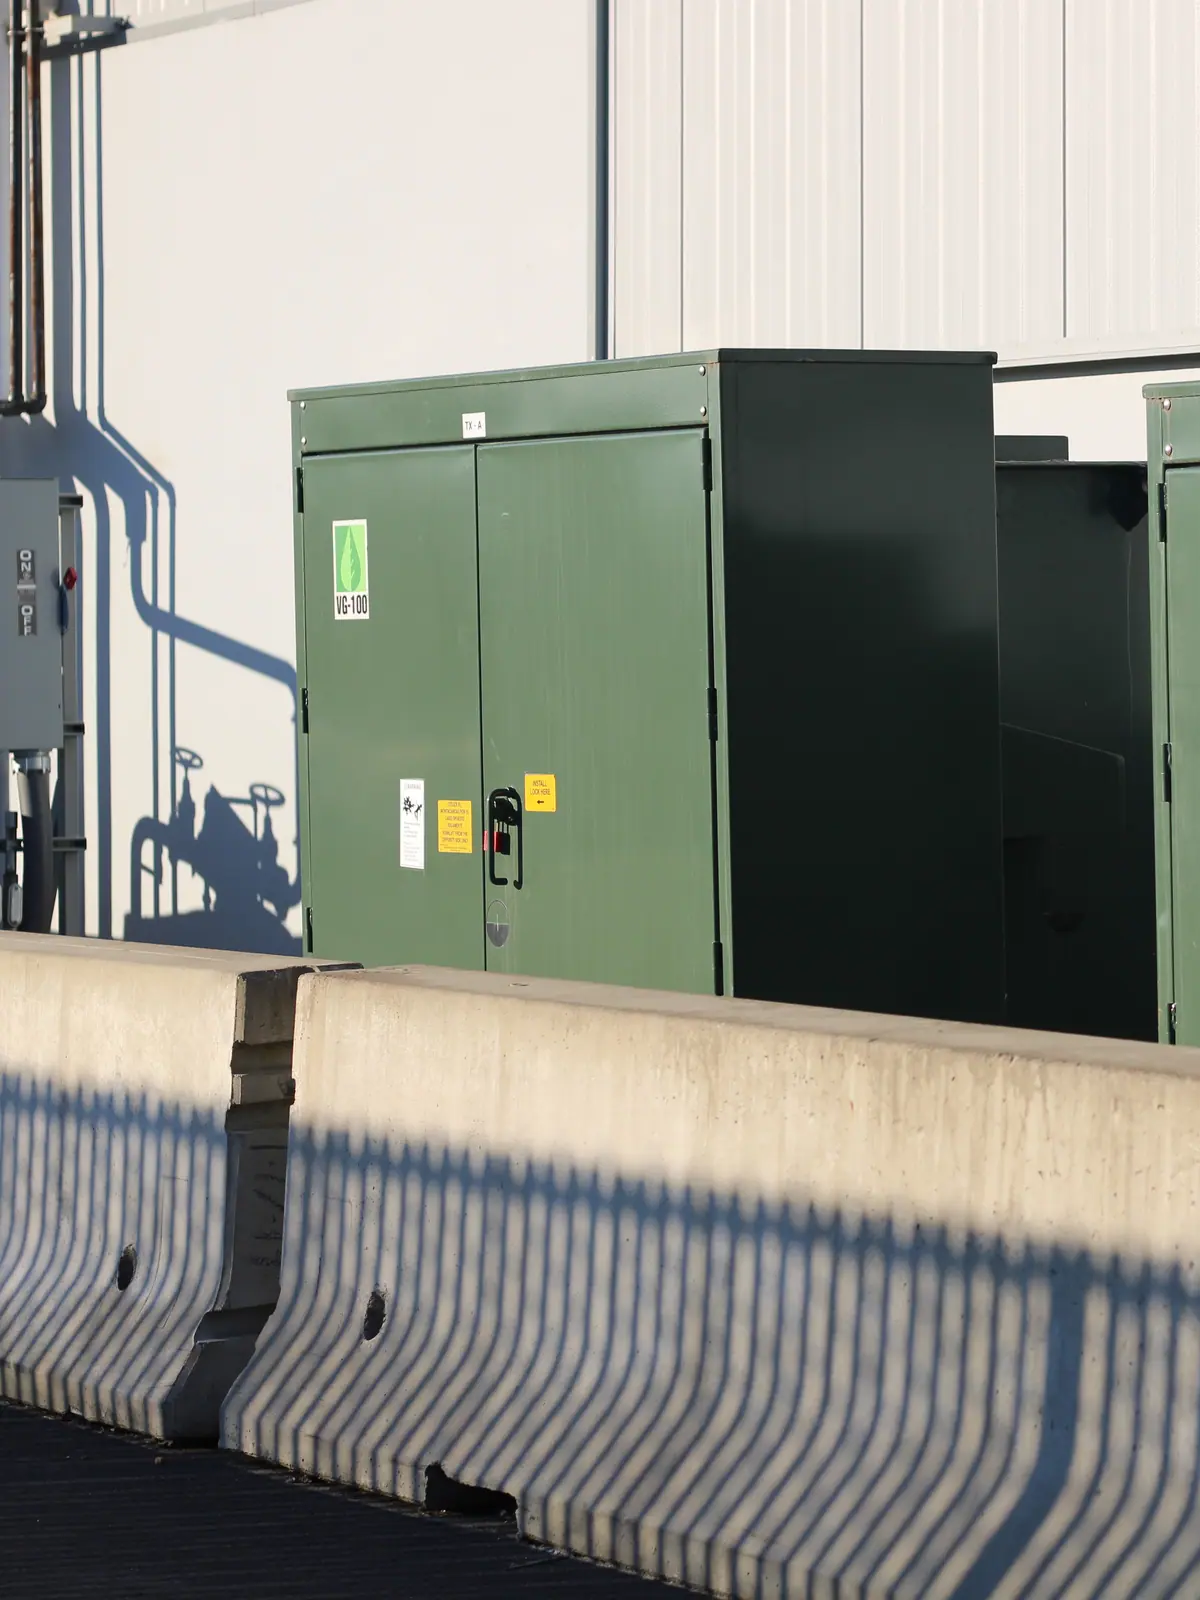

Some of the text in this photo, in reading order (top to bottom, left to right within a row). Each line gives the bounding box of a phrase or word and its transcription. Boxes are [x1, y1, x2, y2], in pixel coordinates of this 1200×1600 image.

[19, 549, 32, 572] ON
[336, 594, 368, 615] VG-100
[21, 605, 33, 636] OFF
